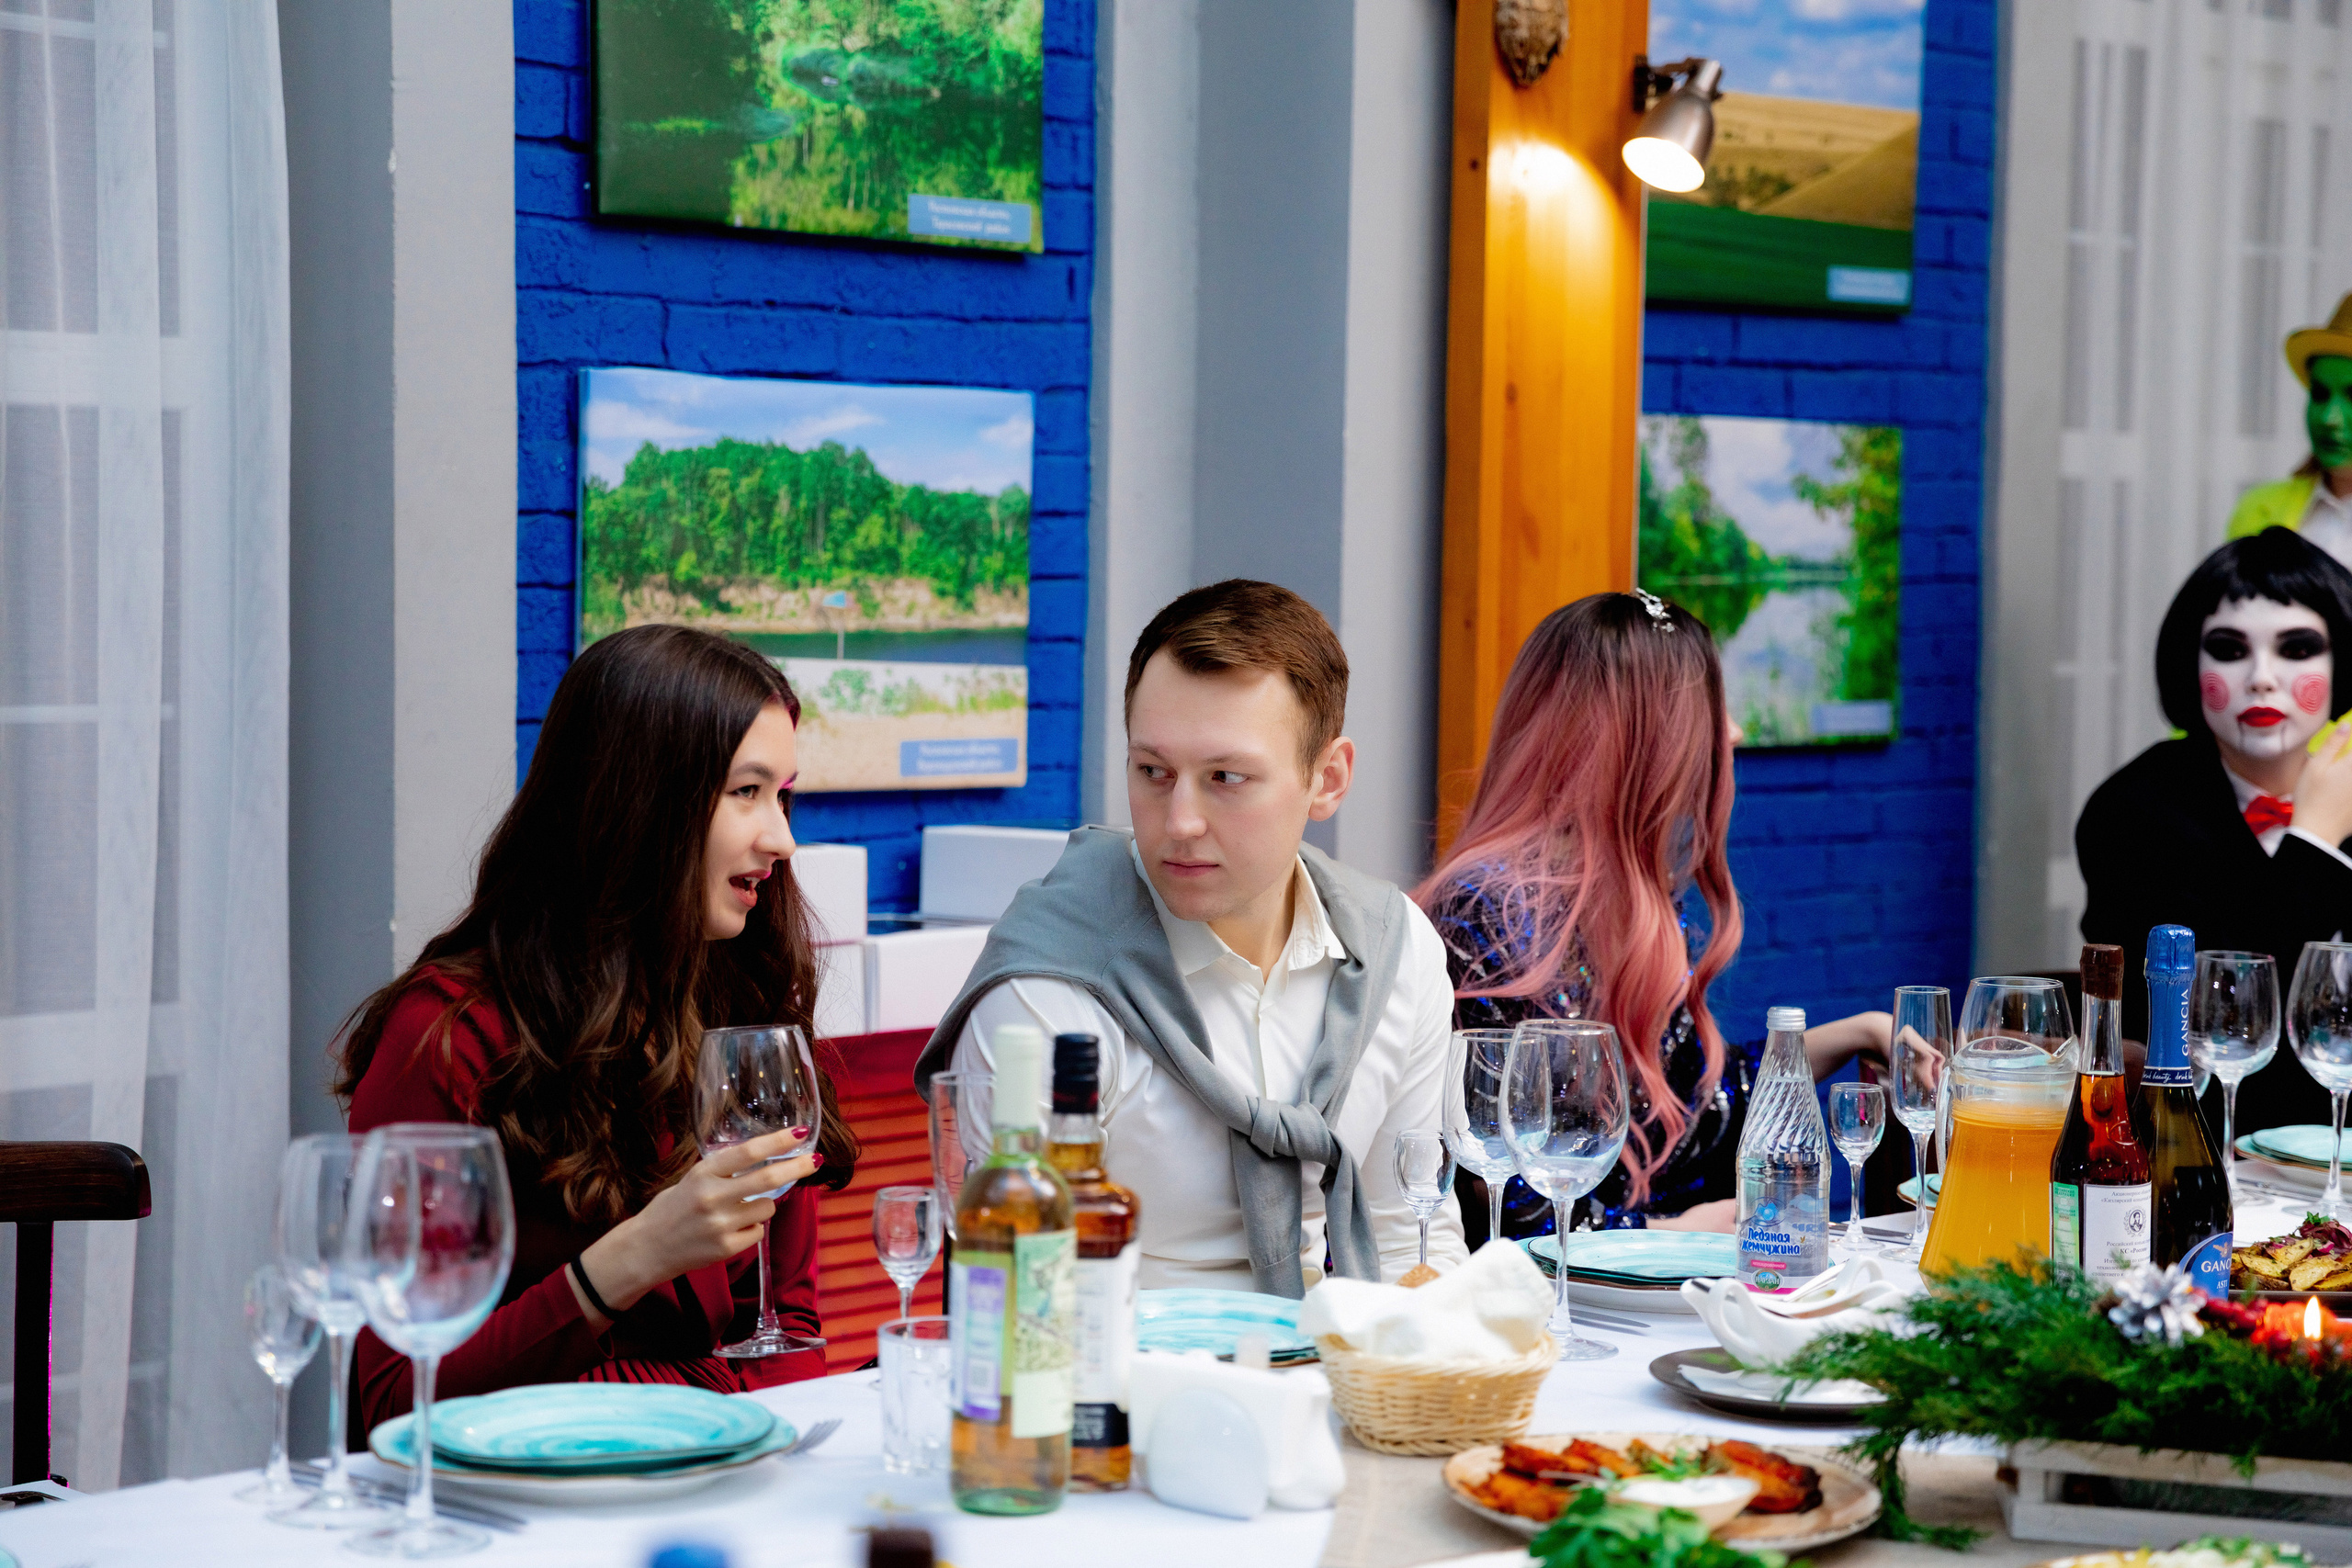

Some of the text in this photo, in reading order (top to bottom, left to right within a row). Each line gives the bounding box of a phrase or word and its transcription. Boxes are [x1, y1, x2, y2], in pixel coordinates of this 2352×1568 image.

[2180, 988, 2189, 1056] GANCIA
[1748, 1227, 1791, 1243] Ледяная
[1741, 1239, 1801, 1256] Жемчужина
